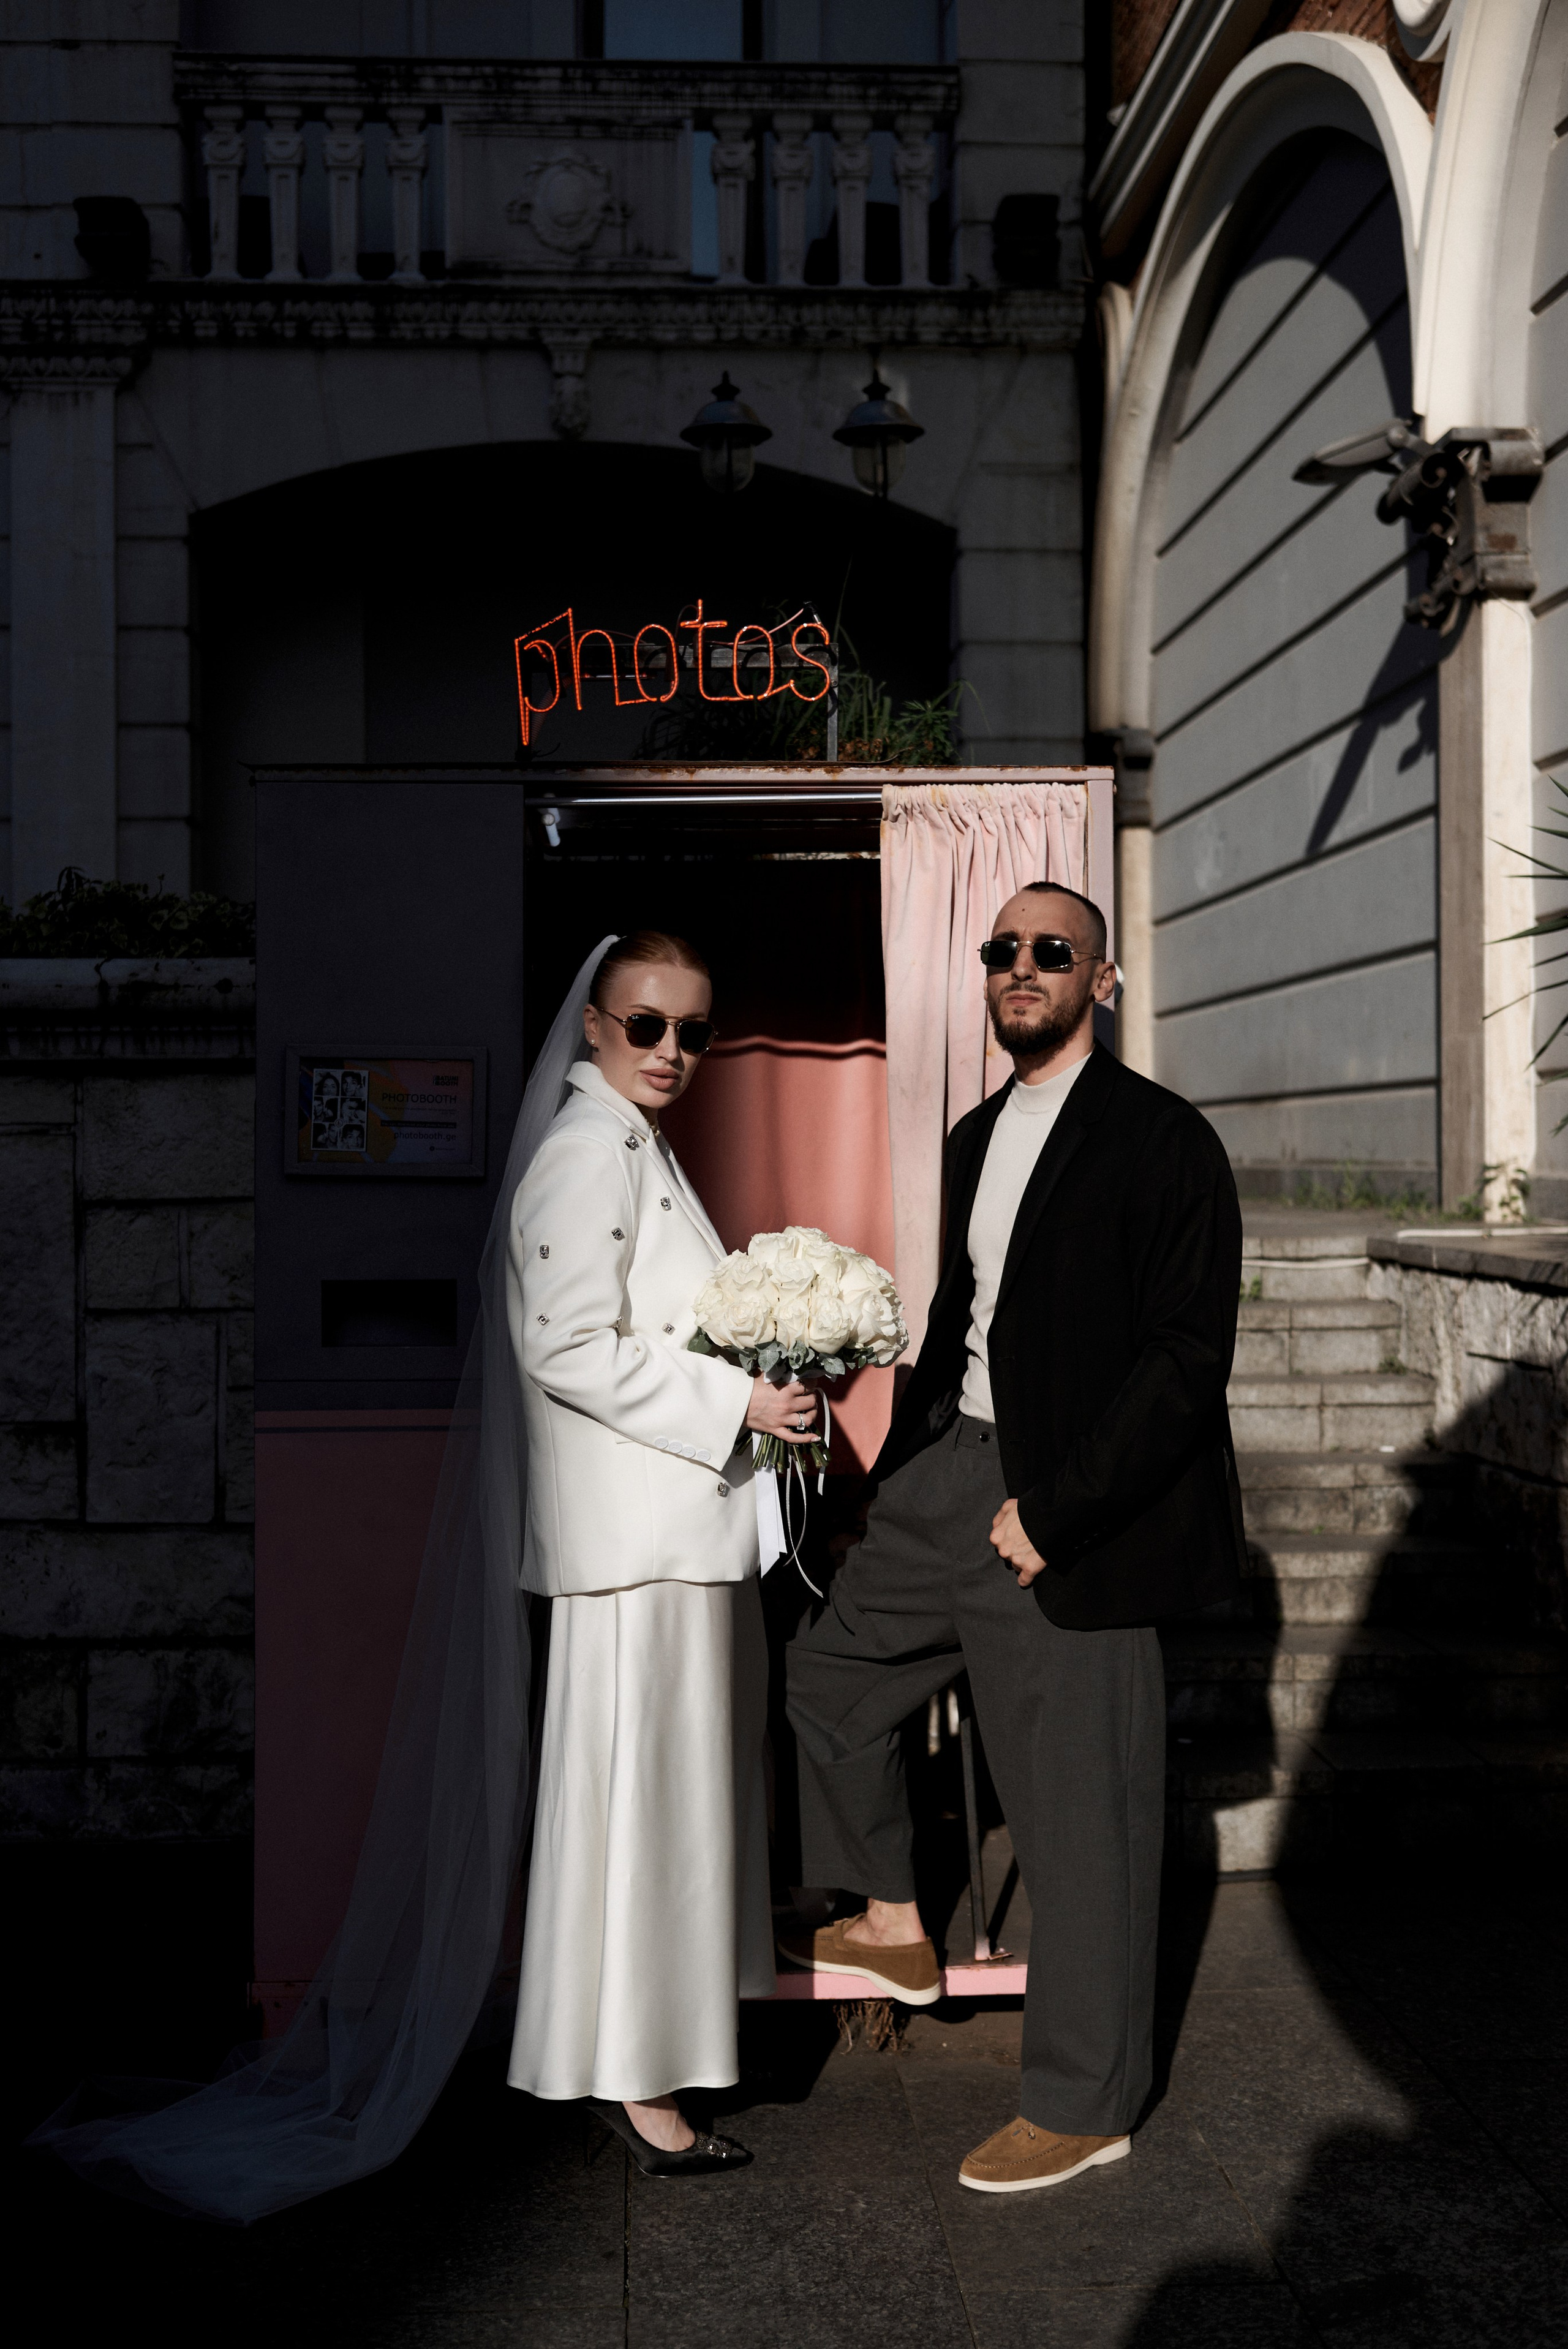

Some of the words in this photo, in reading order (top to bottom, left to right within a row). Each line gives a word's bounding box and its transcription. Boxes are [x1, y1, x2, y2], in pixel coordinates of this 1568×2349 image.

[514, 598, 831, 746] photos
[382, 1093, 457, 1103] PHOTOBOOTH
[394, 1132, 456, 1141] photobooth.ge
